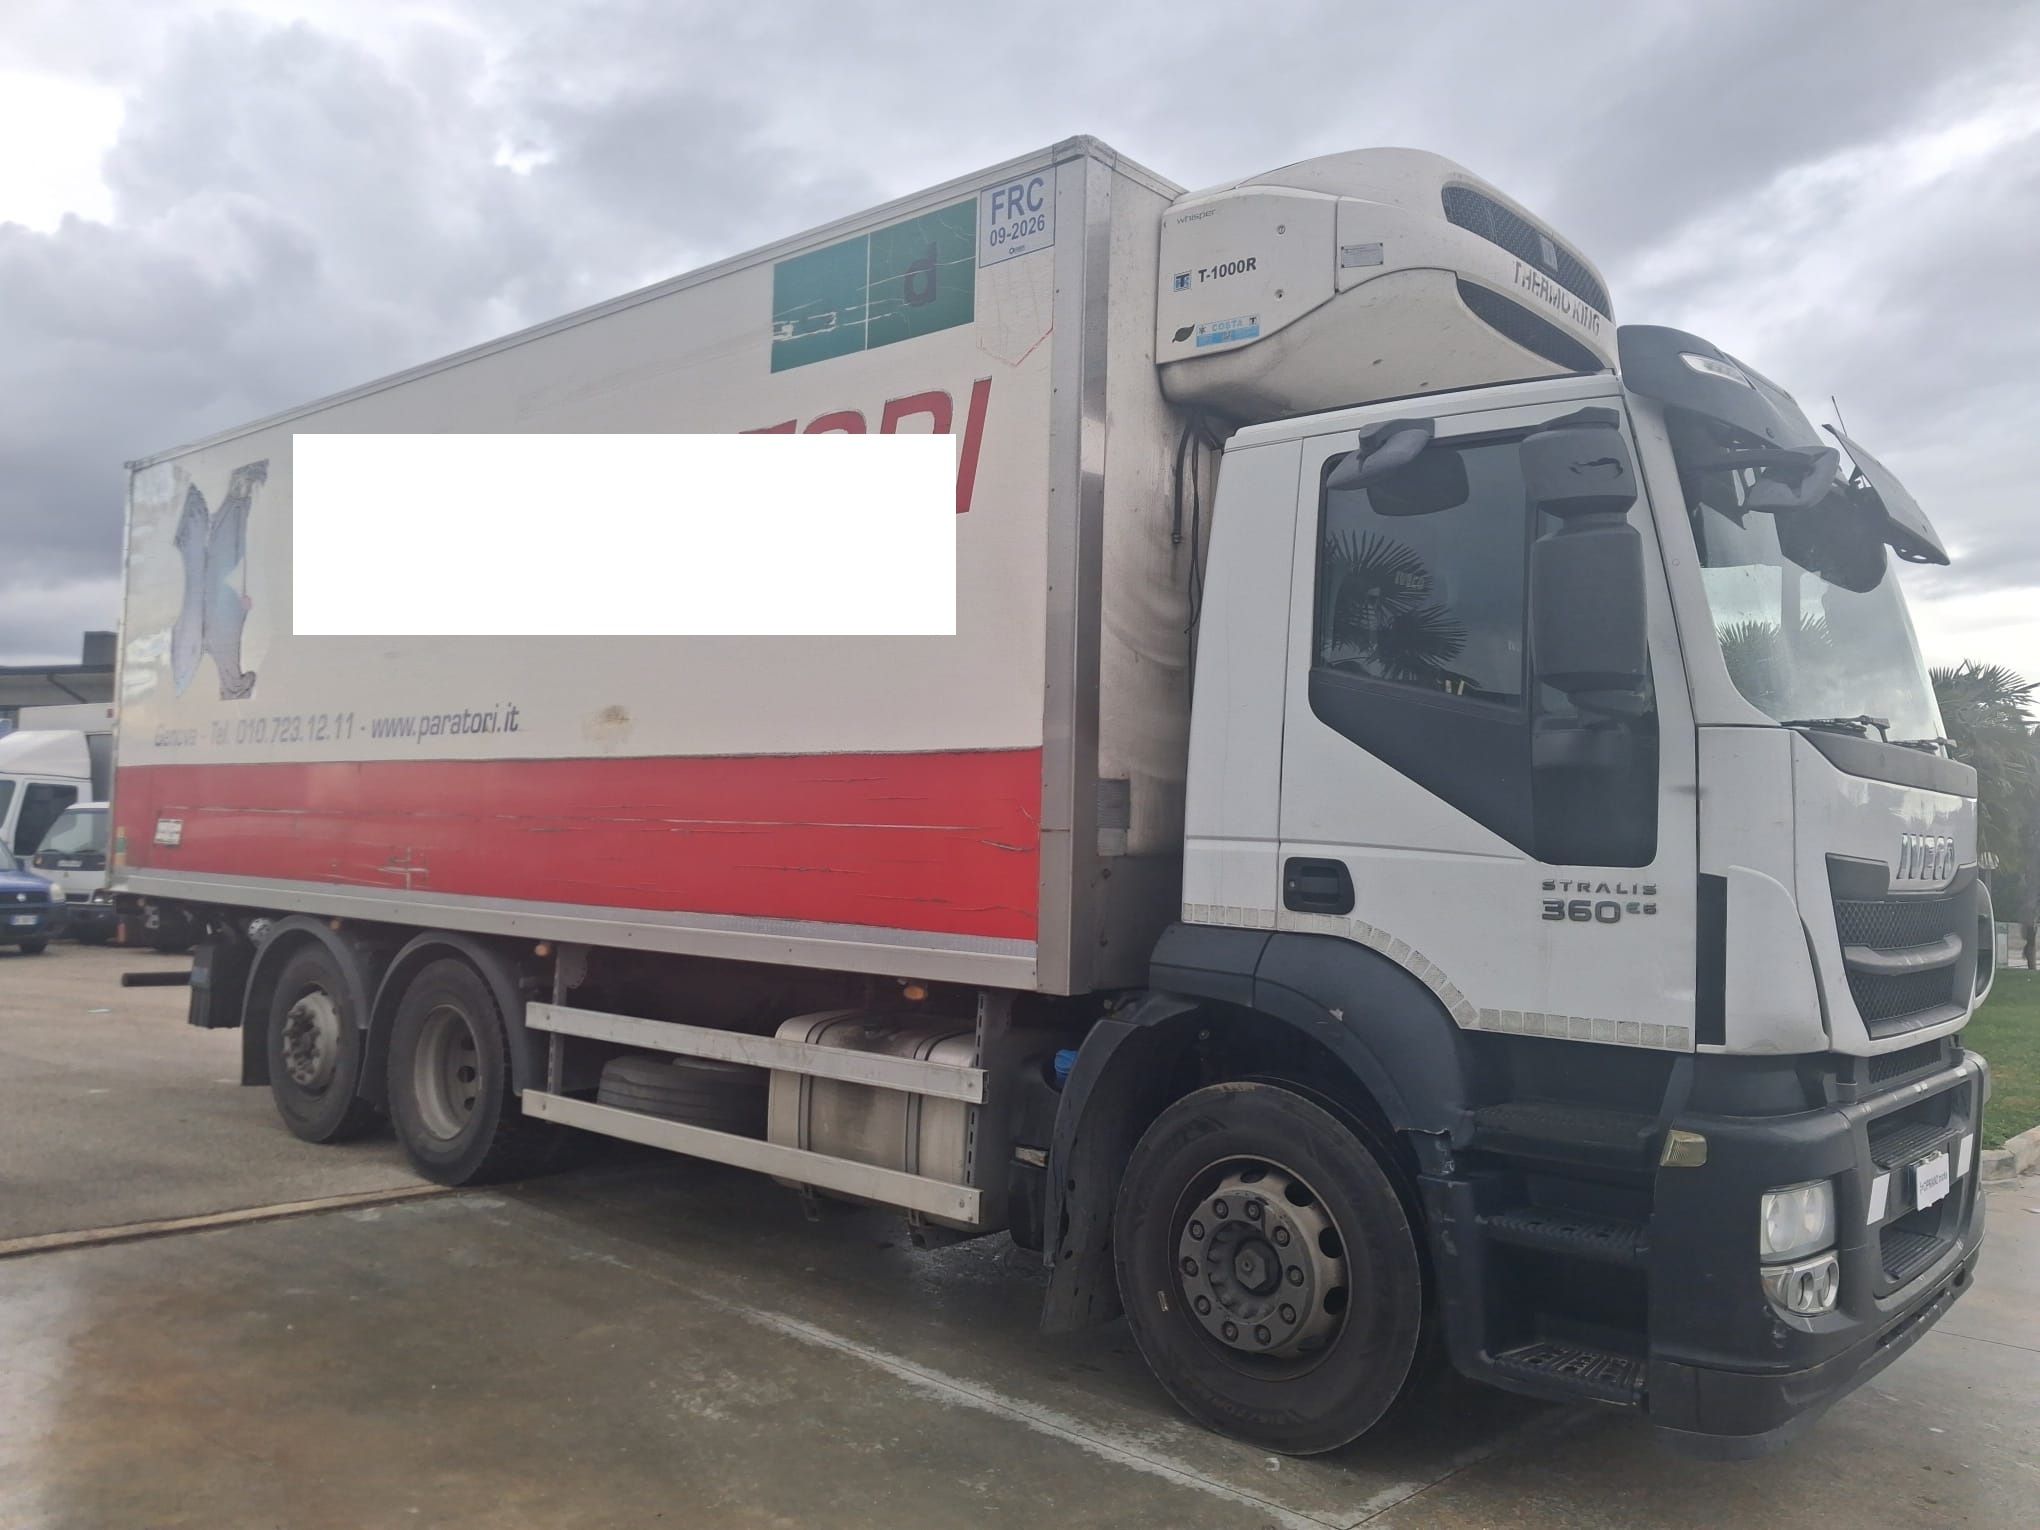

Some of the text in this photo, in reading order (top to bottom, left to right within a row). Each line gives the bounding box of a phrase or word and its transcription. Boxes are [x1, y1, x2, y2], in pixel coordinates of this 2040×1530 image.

[991, 177, 1044, 225] FRC
[1177, 208, 1217, 225] whisper
[990, 214, 1046, 246] 09-2026
[1198, 257, 1257, 283] T-1000R
[1512, 260, 1600, 337] THERMO KING
[235, 713, 354, 745] 010.723.12.11
[371, 702, 519, 745] www.paratori.it
[1896, 832, 1955, 881] IVECO
[1541, 879, 1657, 896] STRALIS
[1541, 899, 1621, 923] 360
